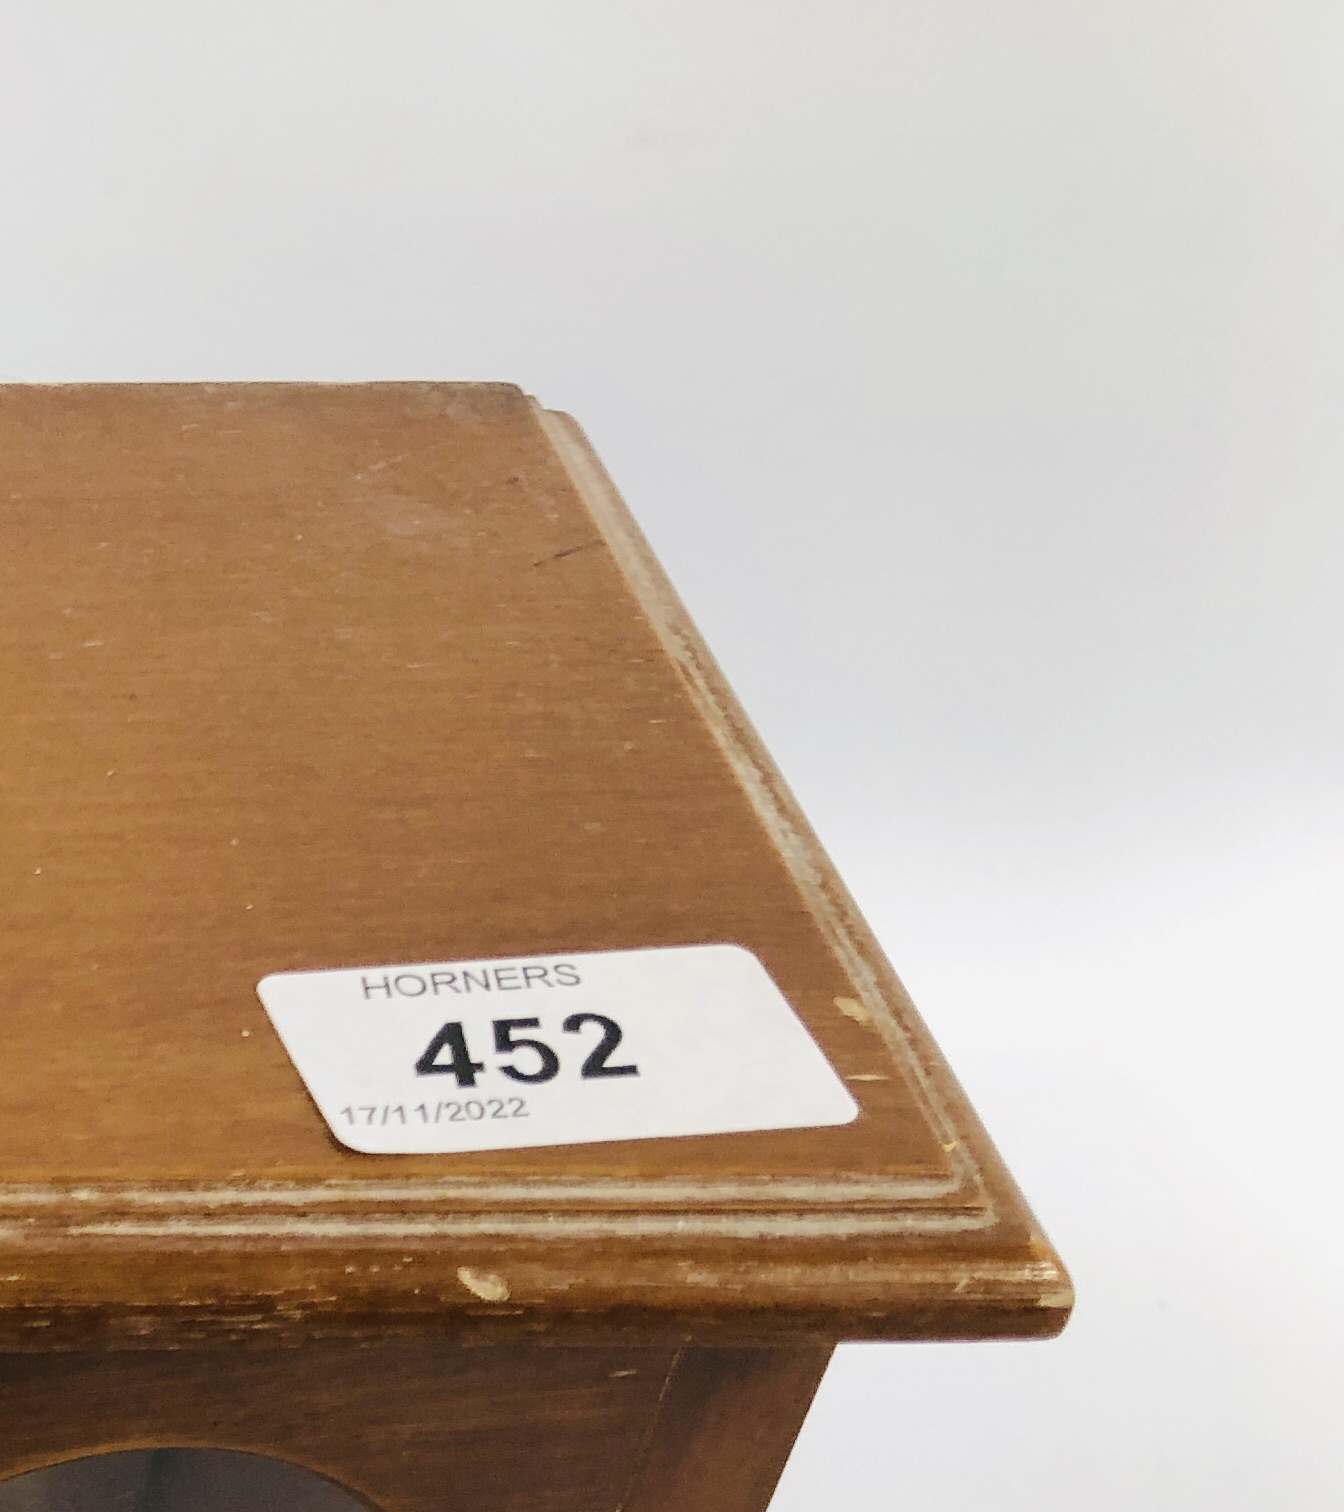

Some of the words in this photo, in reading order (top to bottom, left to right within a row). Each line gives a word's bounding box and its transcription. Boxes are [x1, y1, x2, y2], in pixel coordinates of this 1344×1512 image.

[361, 963, 581, 1000] HORNERS
[414, 1012, 638, 1088] 452
[340, 1097, 529, 1126] 17/11/2022
